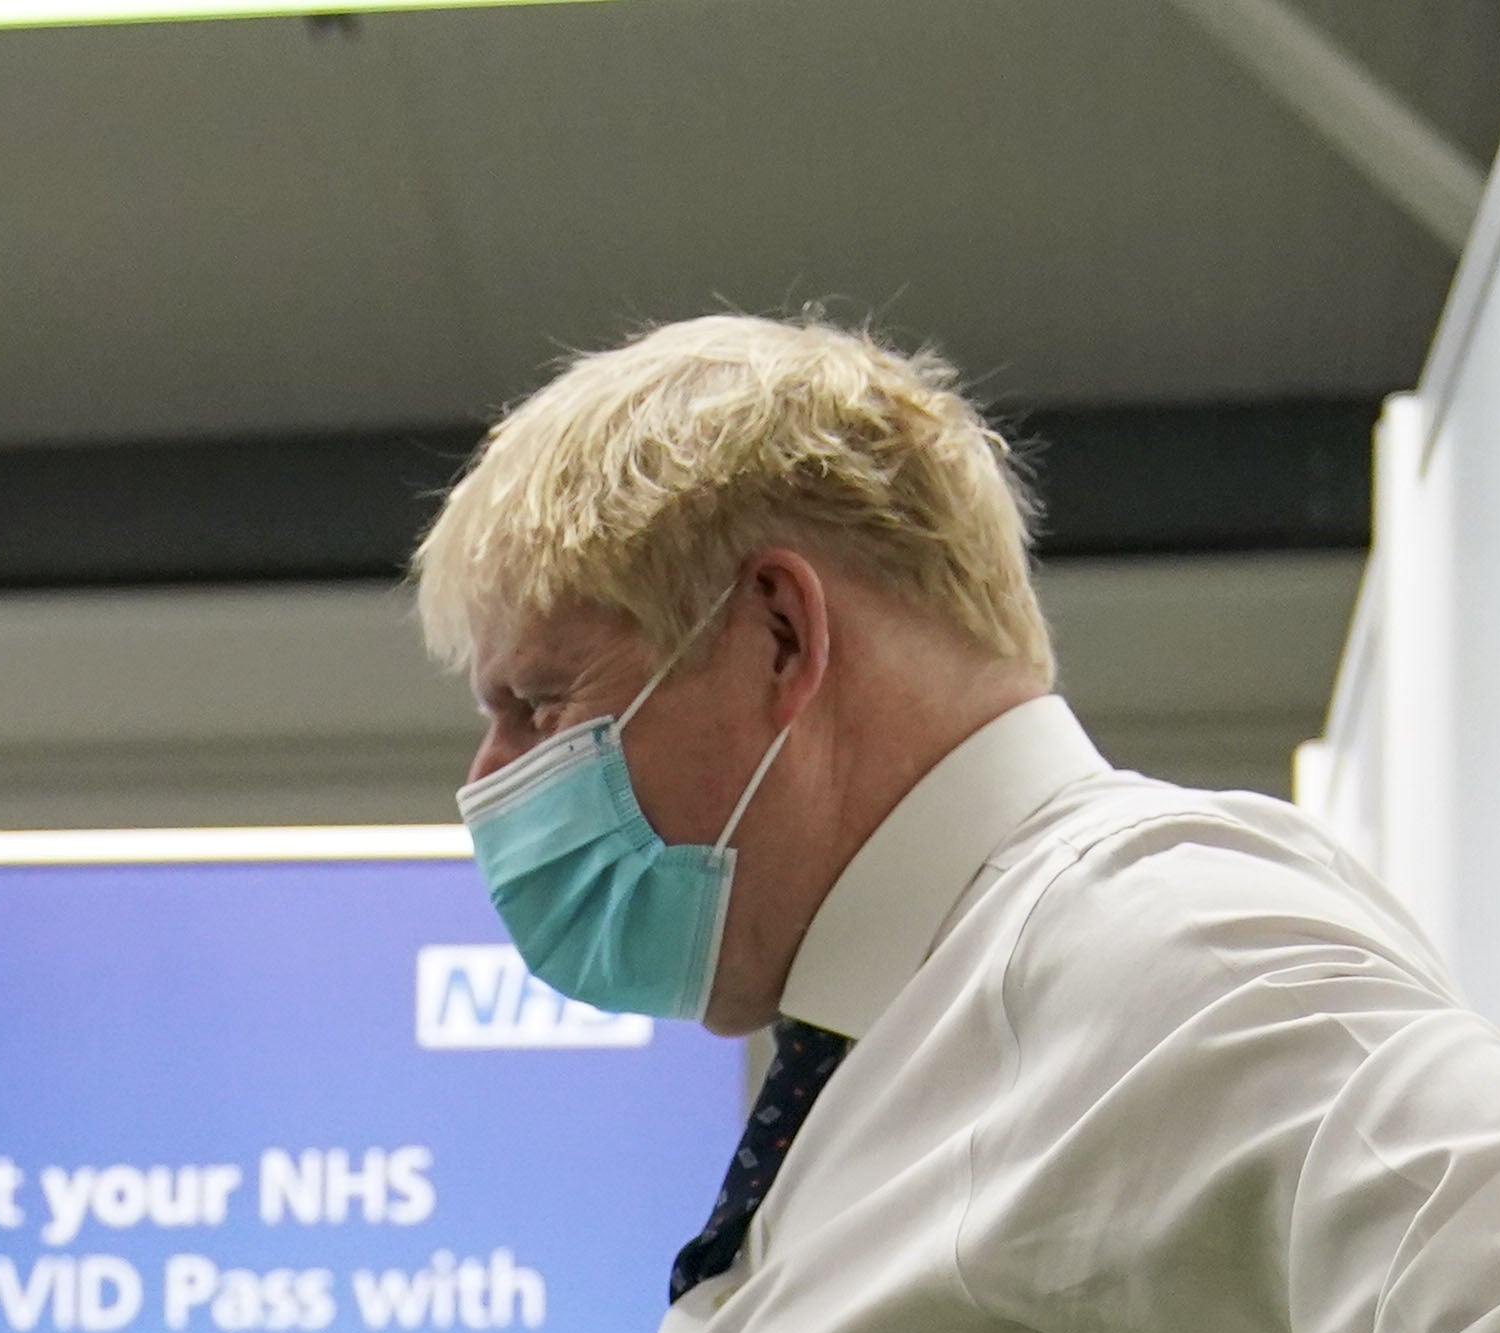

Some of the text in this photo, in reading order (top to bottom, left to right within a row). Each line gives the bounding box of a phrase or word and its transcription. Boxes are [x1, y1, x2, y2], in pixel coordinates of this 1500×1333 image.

[436, 964, 622, 1028] NH
[40, 1163, 242, 1246] your
[260, 1145, 436, 1225] NHS
[164, 1253, 336, 1332] Pass
[352, 1246, 546, 1329] with
